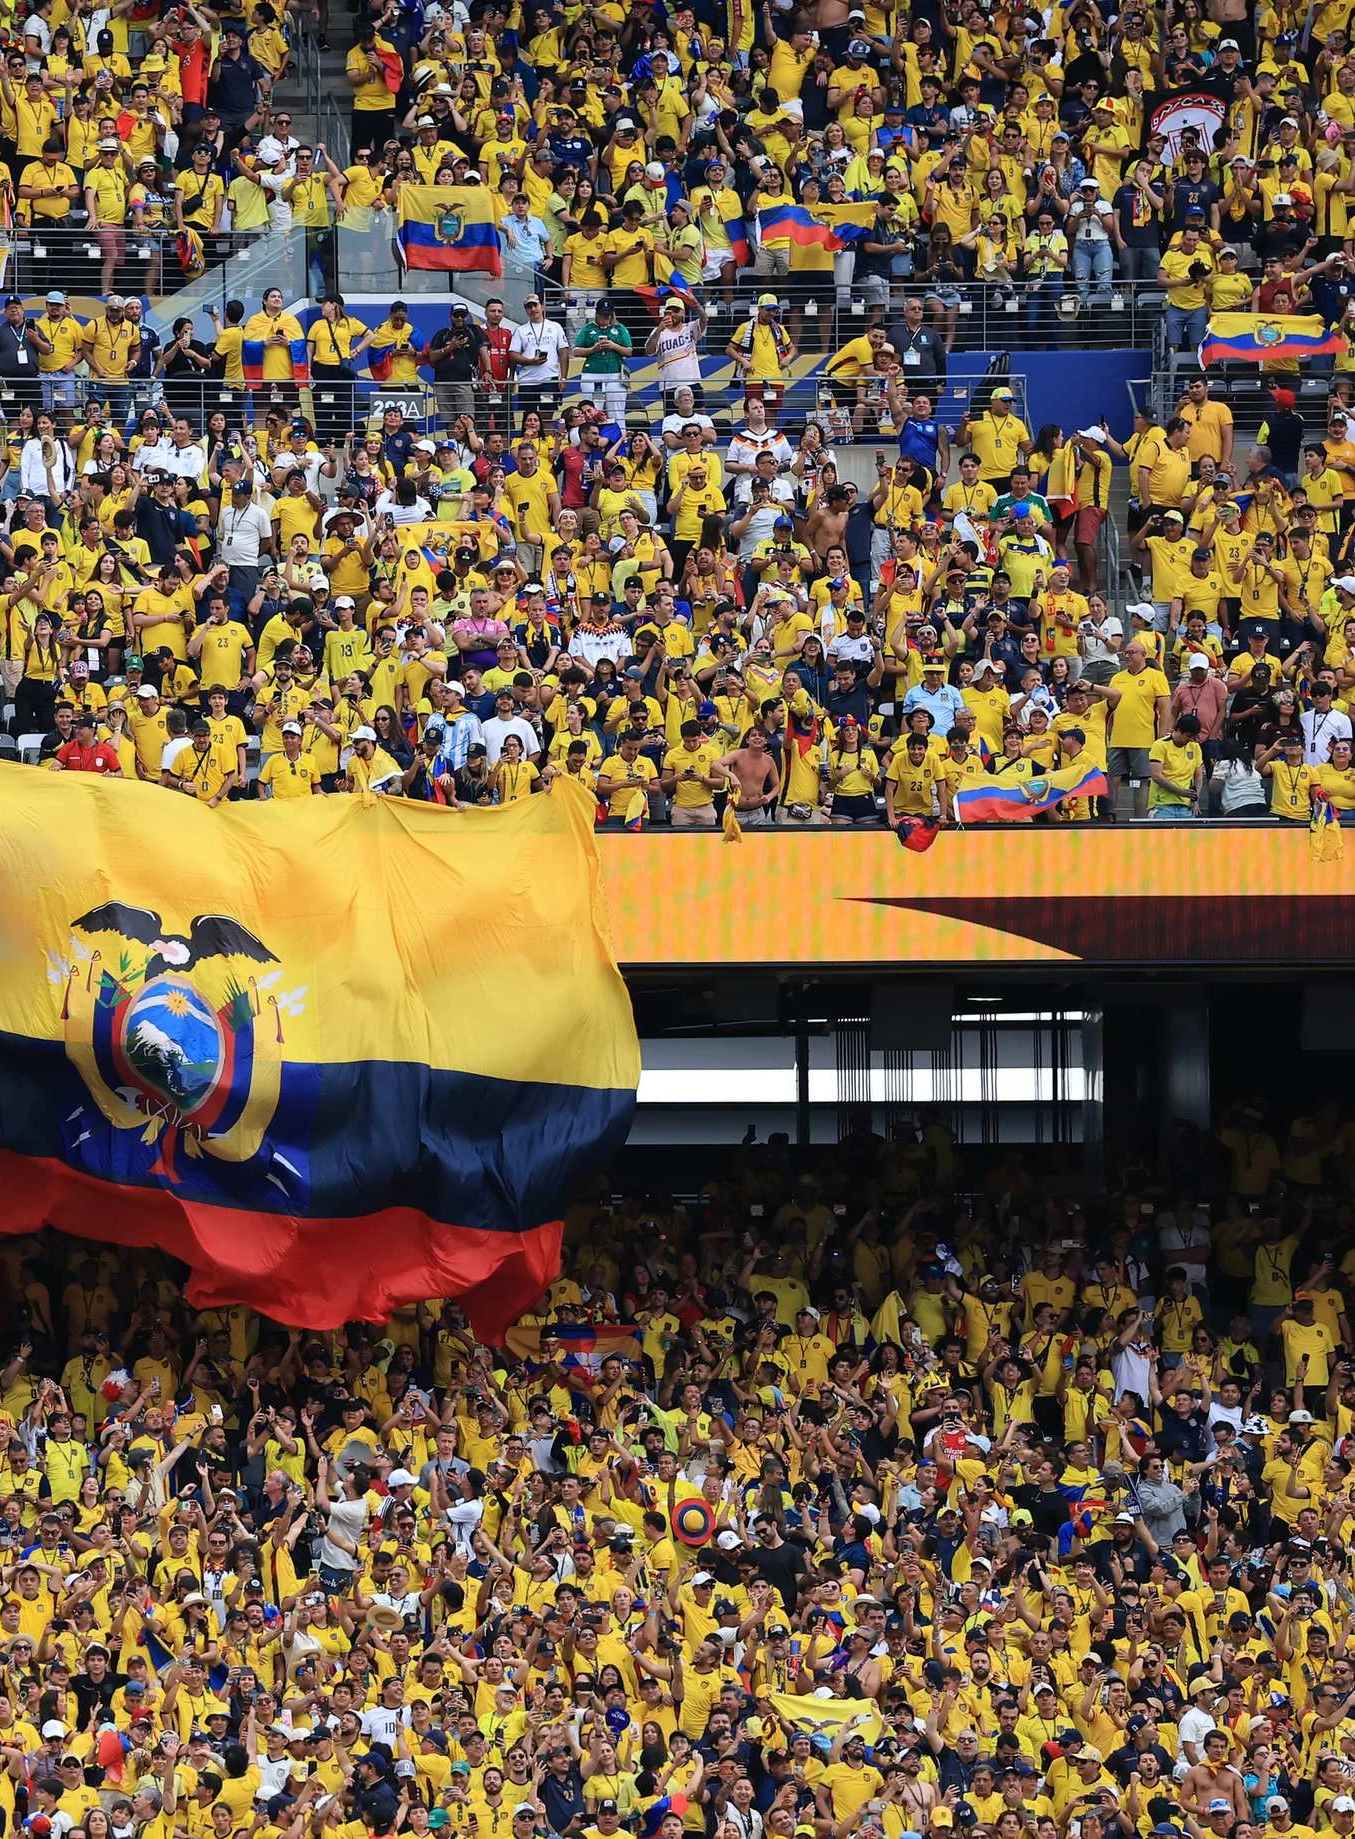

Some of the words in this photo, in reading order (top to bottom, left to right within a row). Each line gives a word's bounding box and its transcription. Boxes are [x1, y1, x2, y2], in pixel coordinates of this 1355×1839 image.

[1189, 192, 1198, 203] 23
[1230, 547, 1239, 558] 23
[217, 638, 229, 648] 23
[341, 644, 352, 657] 13
[213, 734, 224, 744] 23
[910, 781, 922, 791] 23
[385, 1721, 395, 1734] 10
